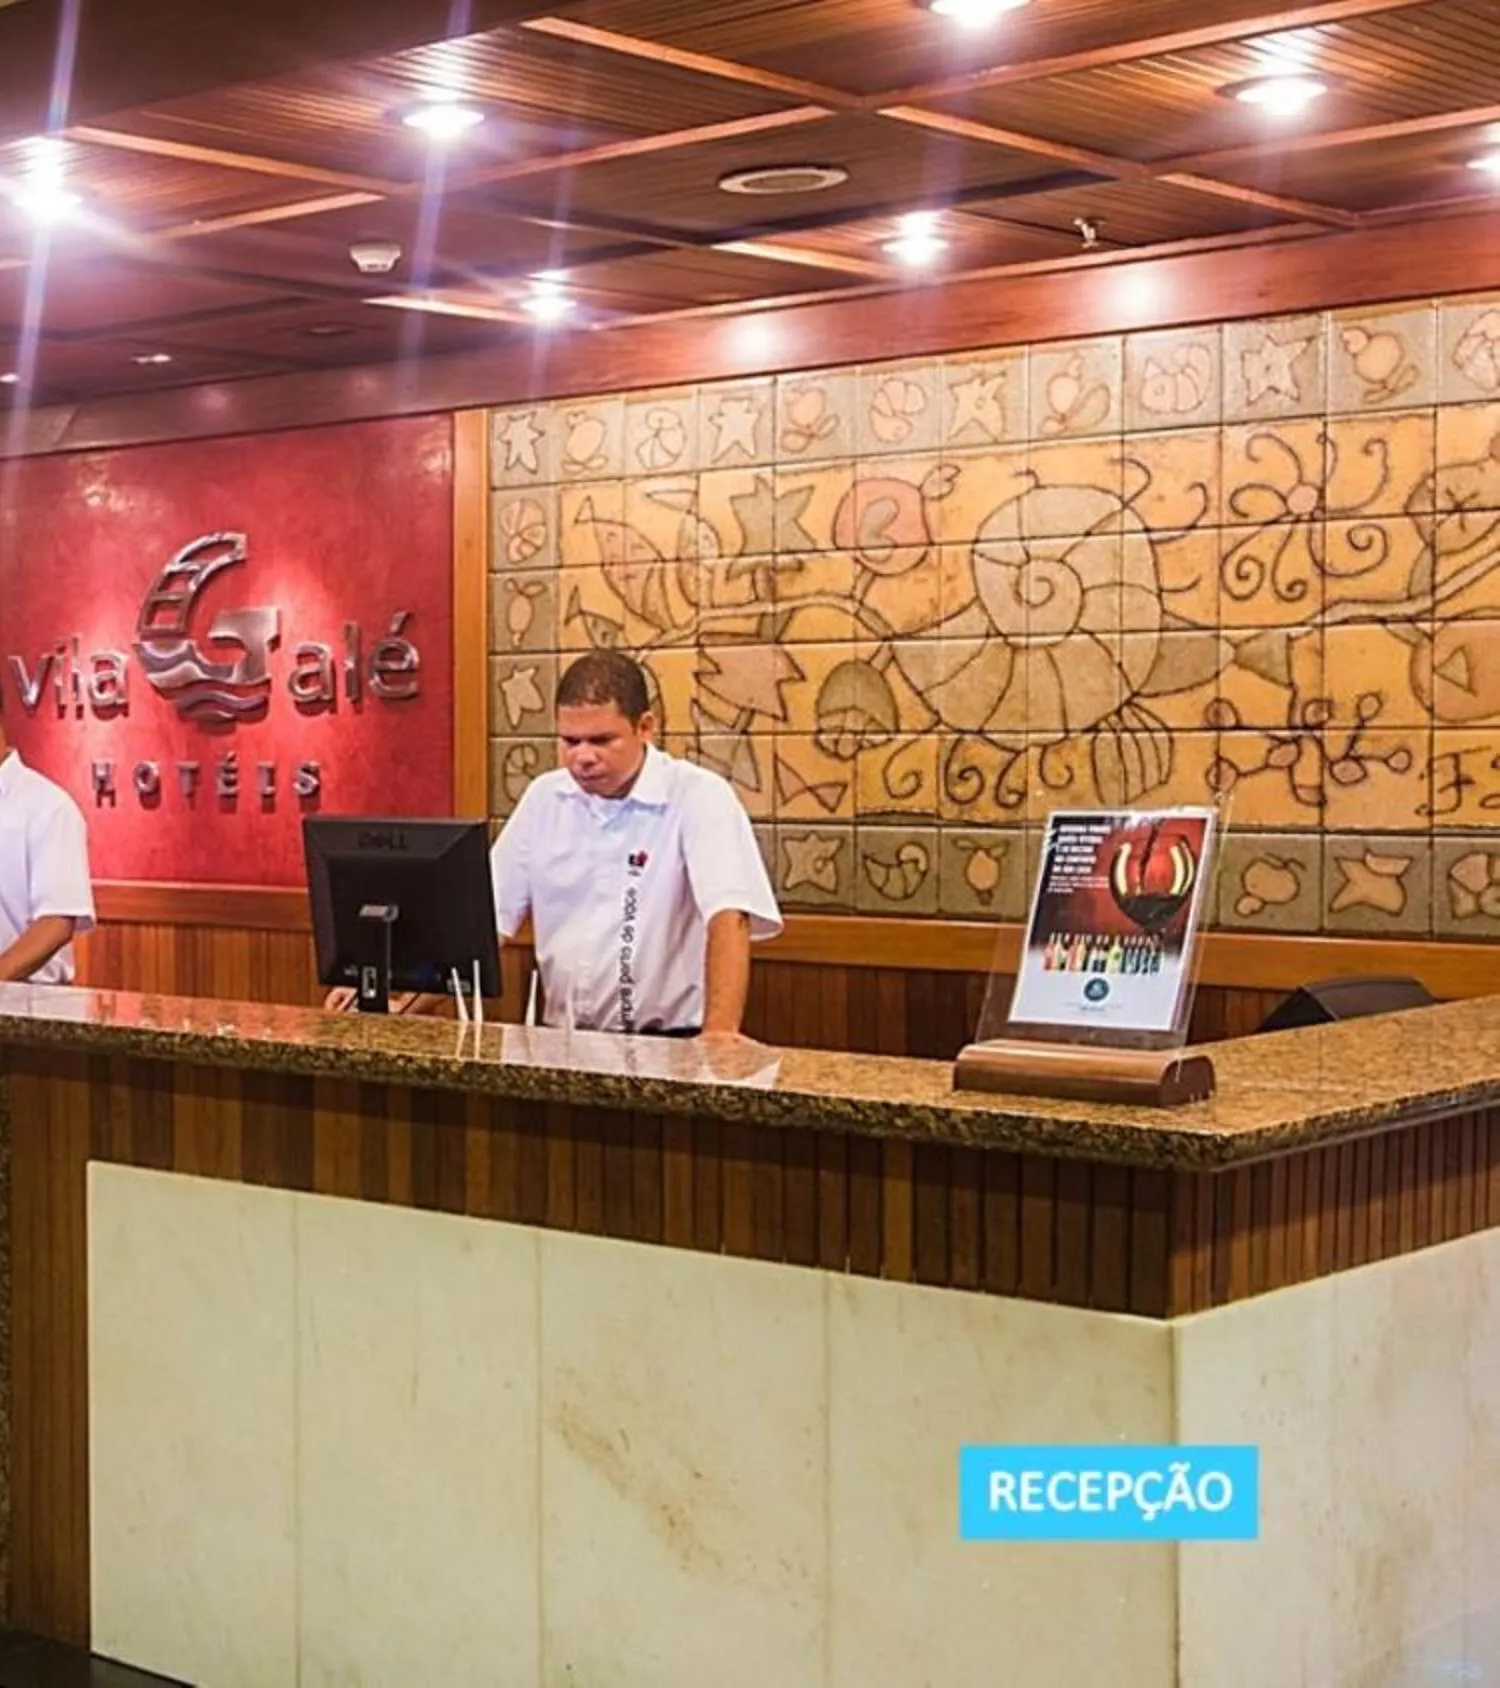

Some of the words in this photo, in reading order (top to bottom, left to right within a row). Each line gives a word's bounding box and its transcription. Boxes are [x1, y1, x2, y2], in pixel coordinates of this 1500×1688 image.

[91, 752, 323, 801] HOTÉIS
[358, 828, 410, 851] DELL
[621, 925, 636, 944] de
